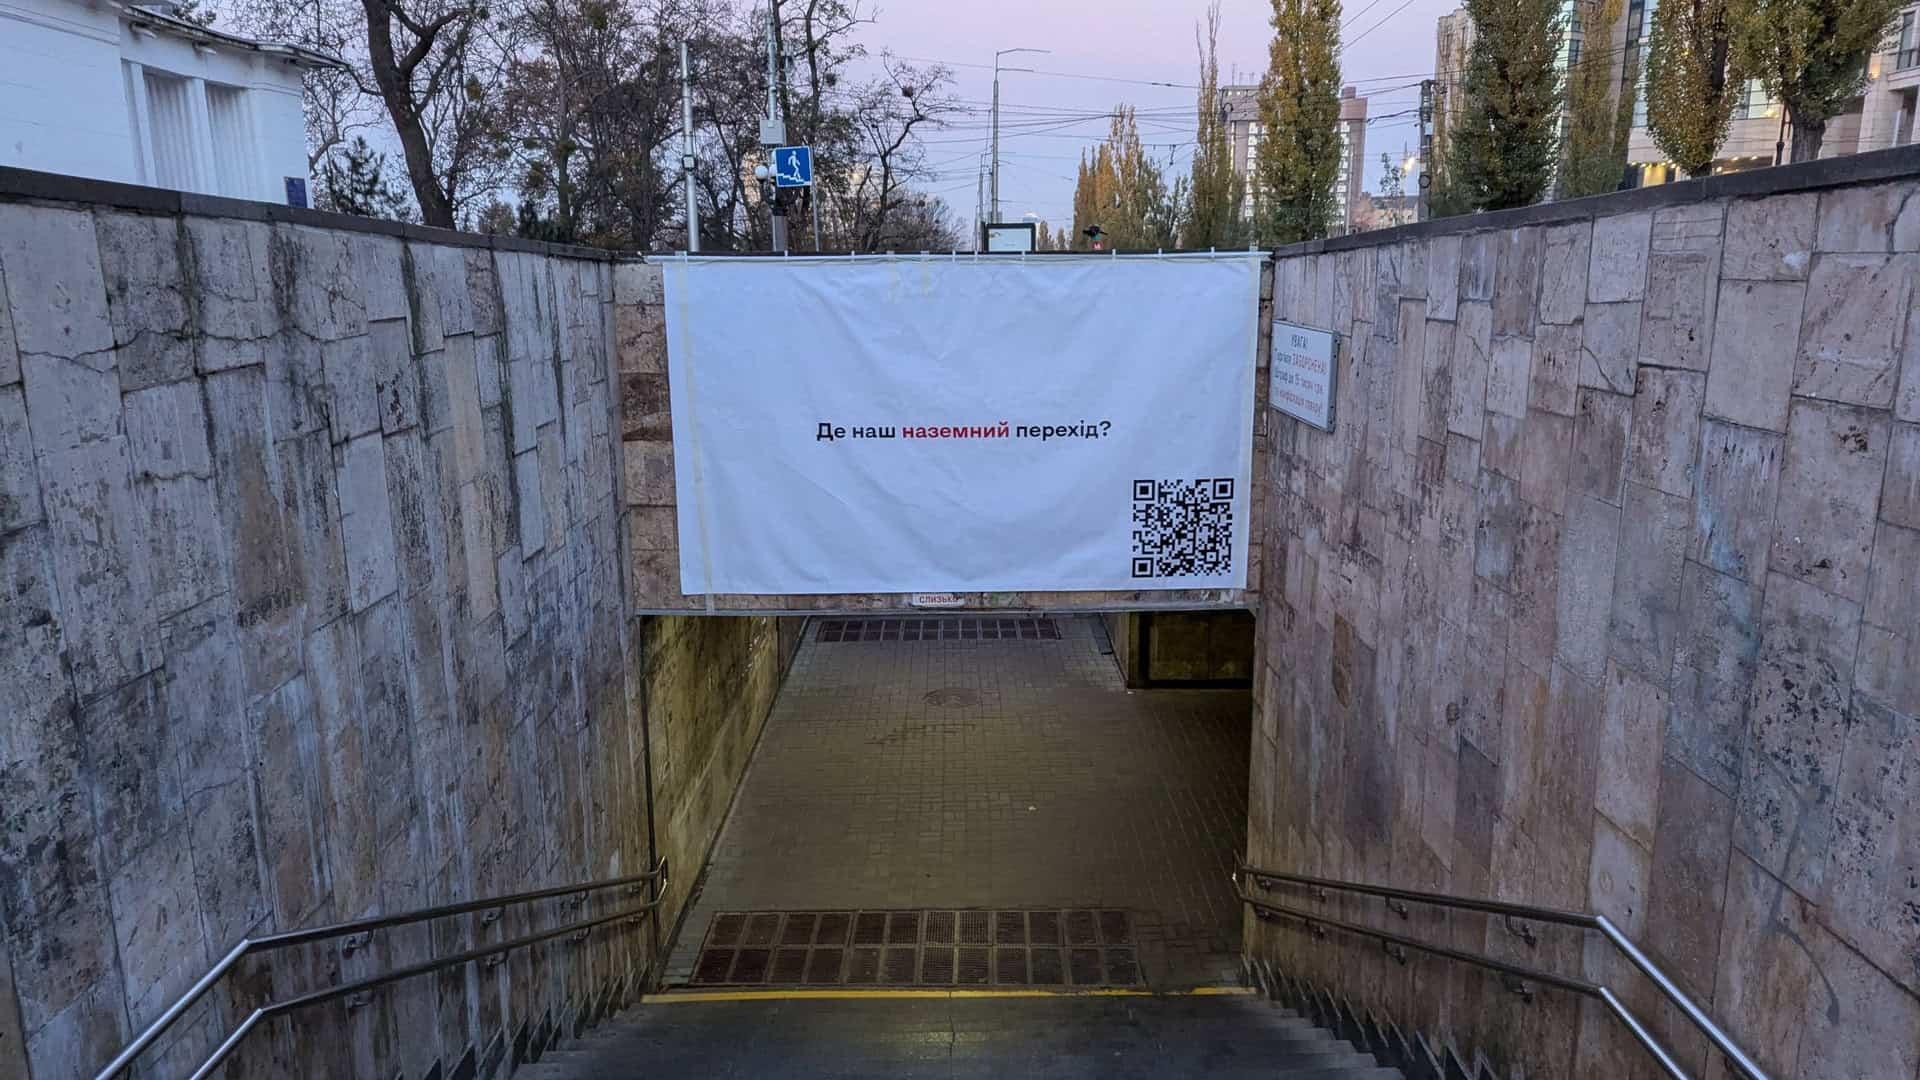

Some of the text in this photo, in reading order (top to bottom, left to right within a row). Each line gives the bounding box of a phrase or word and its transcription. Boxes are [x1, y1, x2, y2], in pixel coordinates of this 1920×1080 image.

[817, 420, 1112, 442] Де наш наземний перехід?
